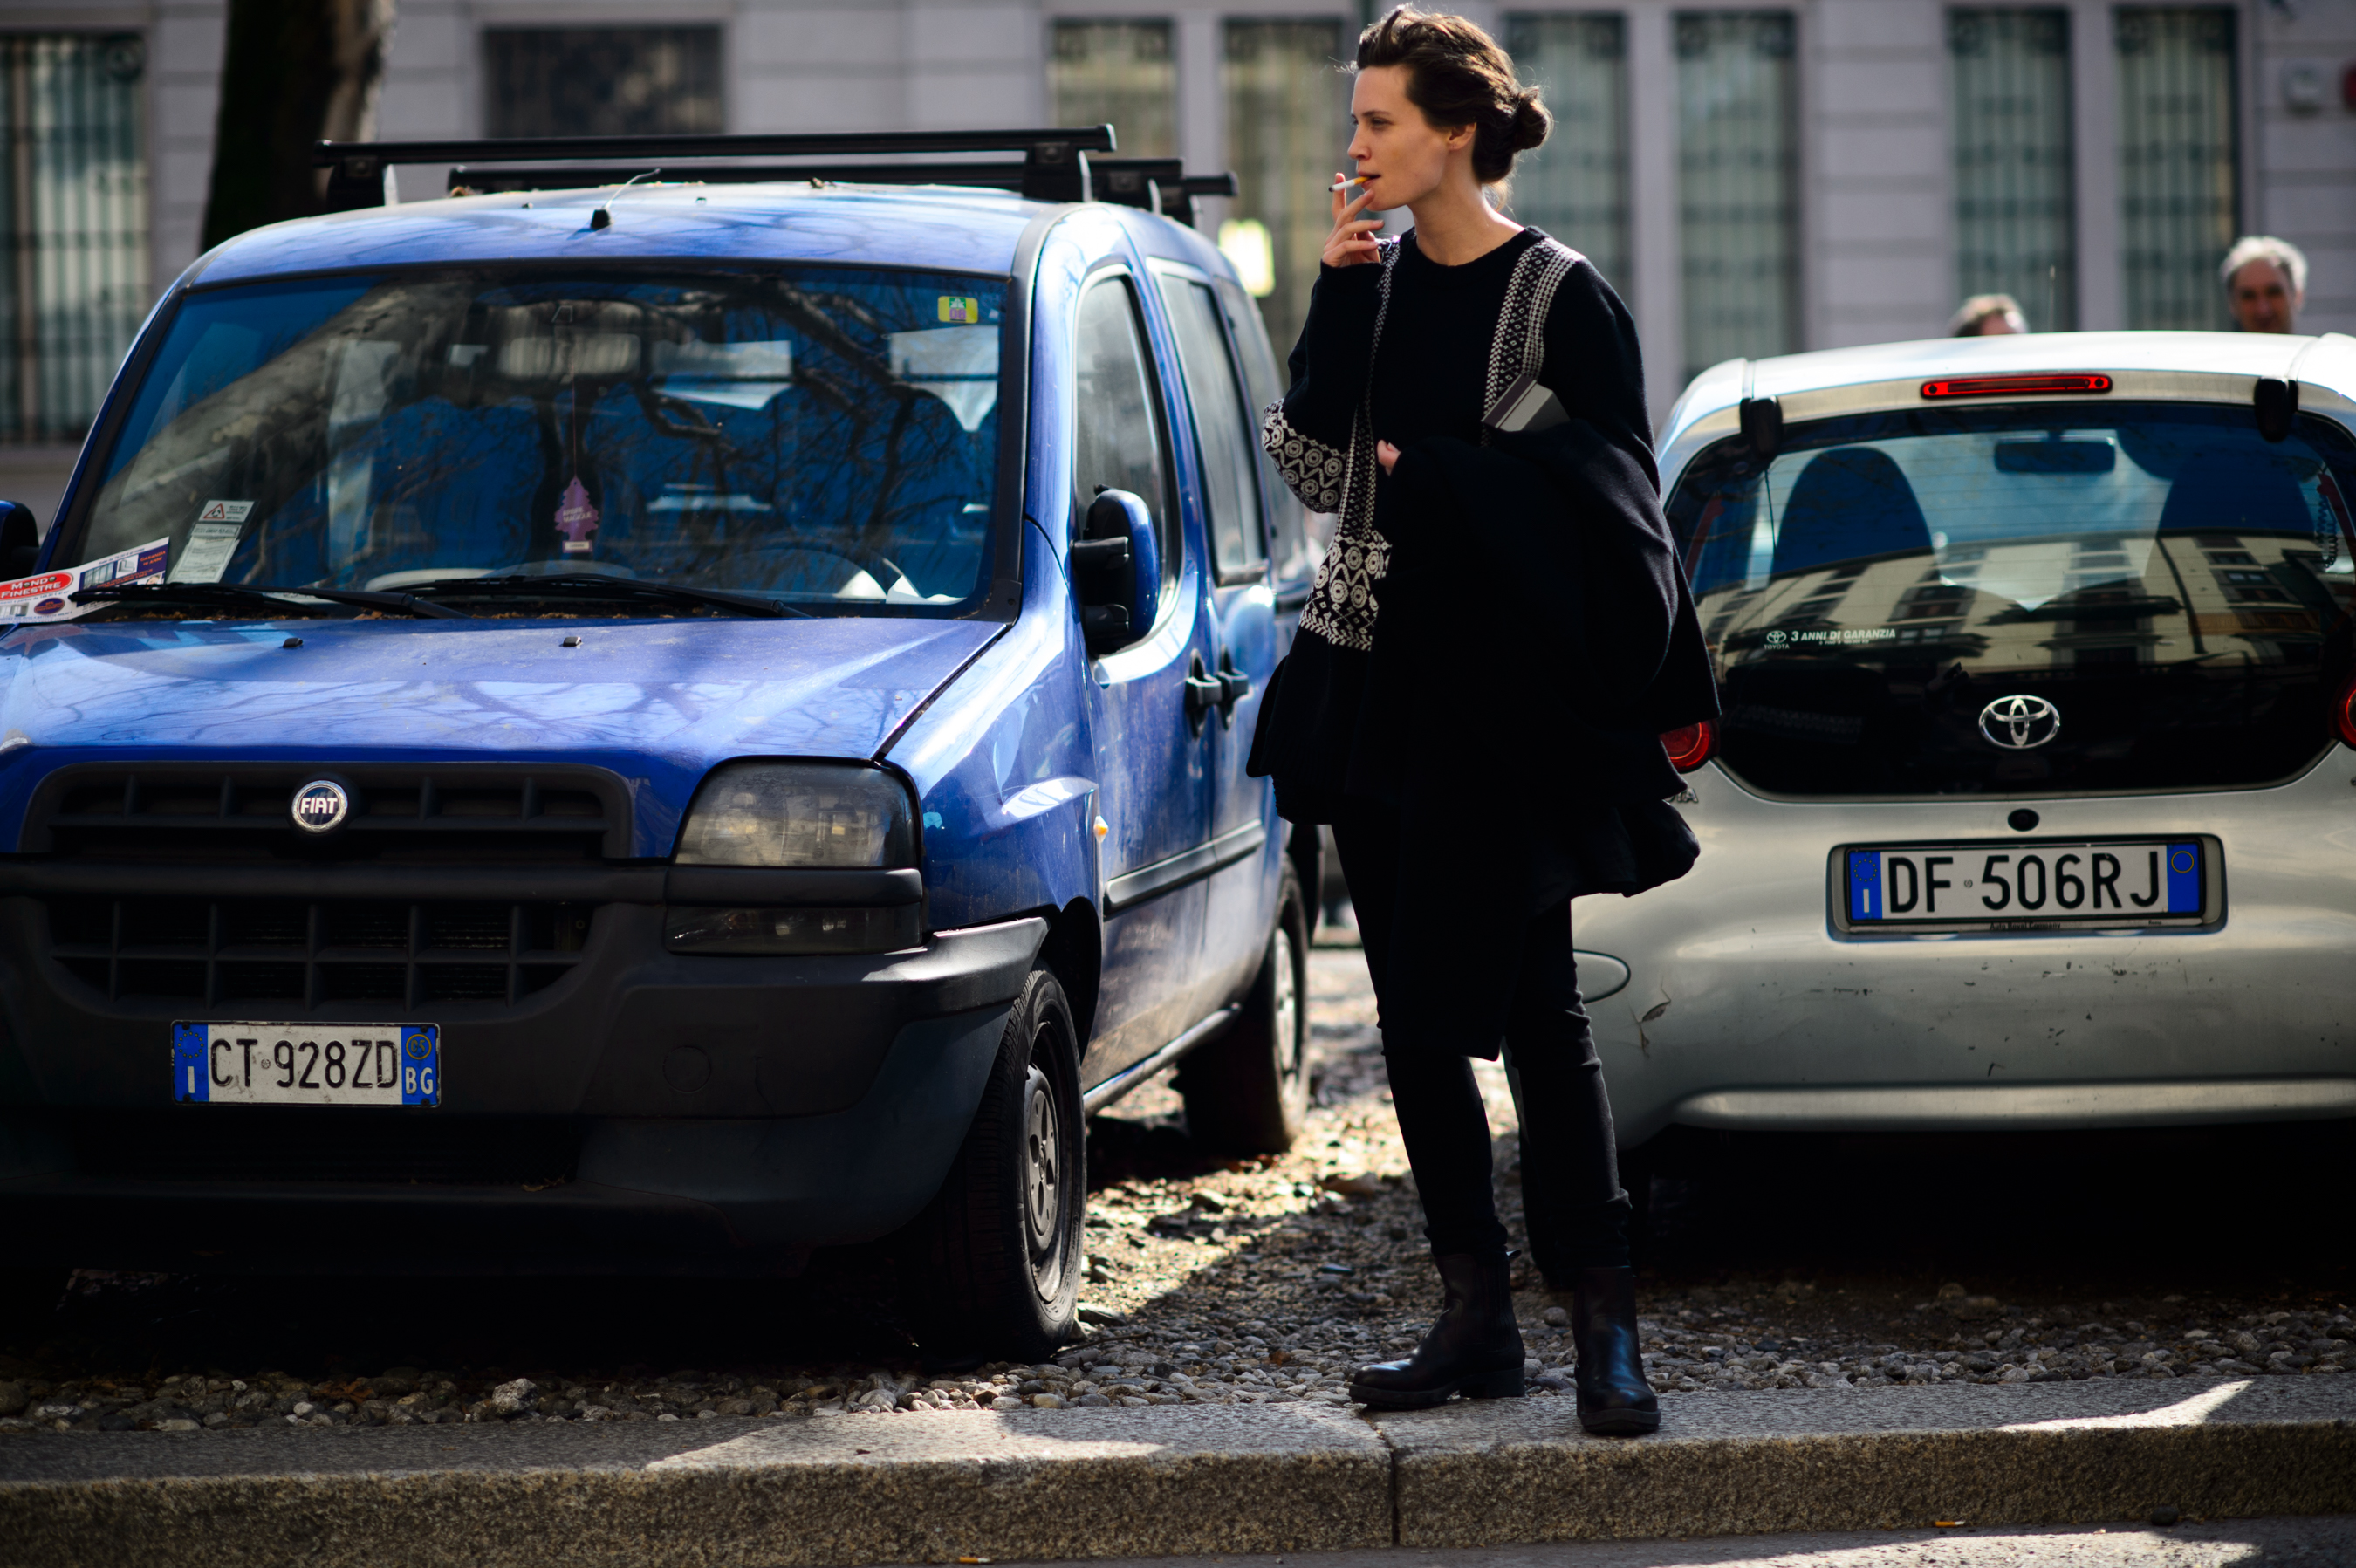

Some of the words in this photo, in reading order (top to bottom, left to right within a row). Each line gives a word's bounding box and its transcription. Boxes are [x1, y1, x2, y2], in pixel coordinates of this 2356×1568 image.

[949, 308, 966, 319] 08
[1, 581, 62, 599] FINESTRE
[11, 576, 57, 591] MONDO
[1791, 631, 1798, 642] 3
[1801, 631, 1827, 641] ANNI
[1830, 630, 1840, 640] DI
[1844, 628, 1895, 640] GARANZIA
[300, 798, 338, 814] FIAT
[1887, 855, 1954, 914] DF
[1981, 850, 2160, 911] 506RJ
[210, 1038, 258, 1088] CT
[273, 1039, 399, 1089] 928ZD
[405, 1066, 434, 1096] BG
